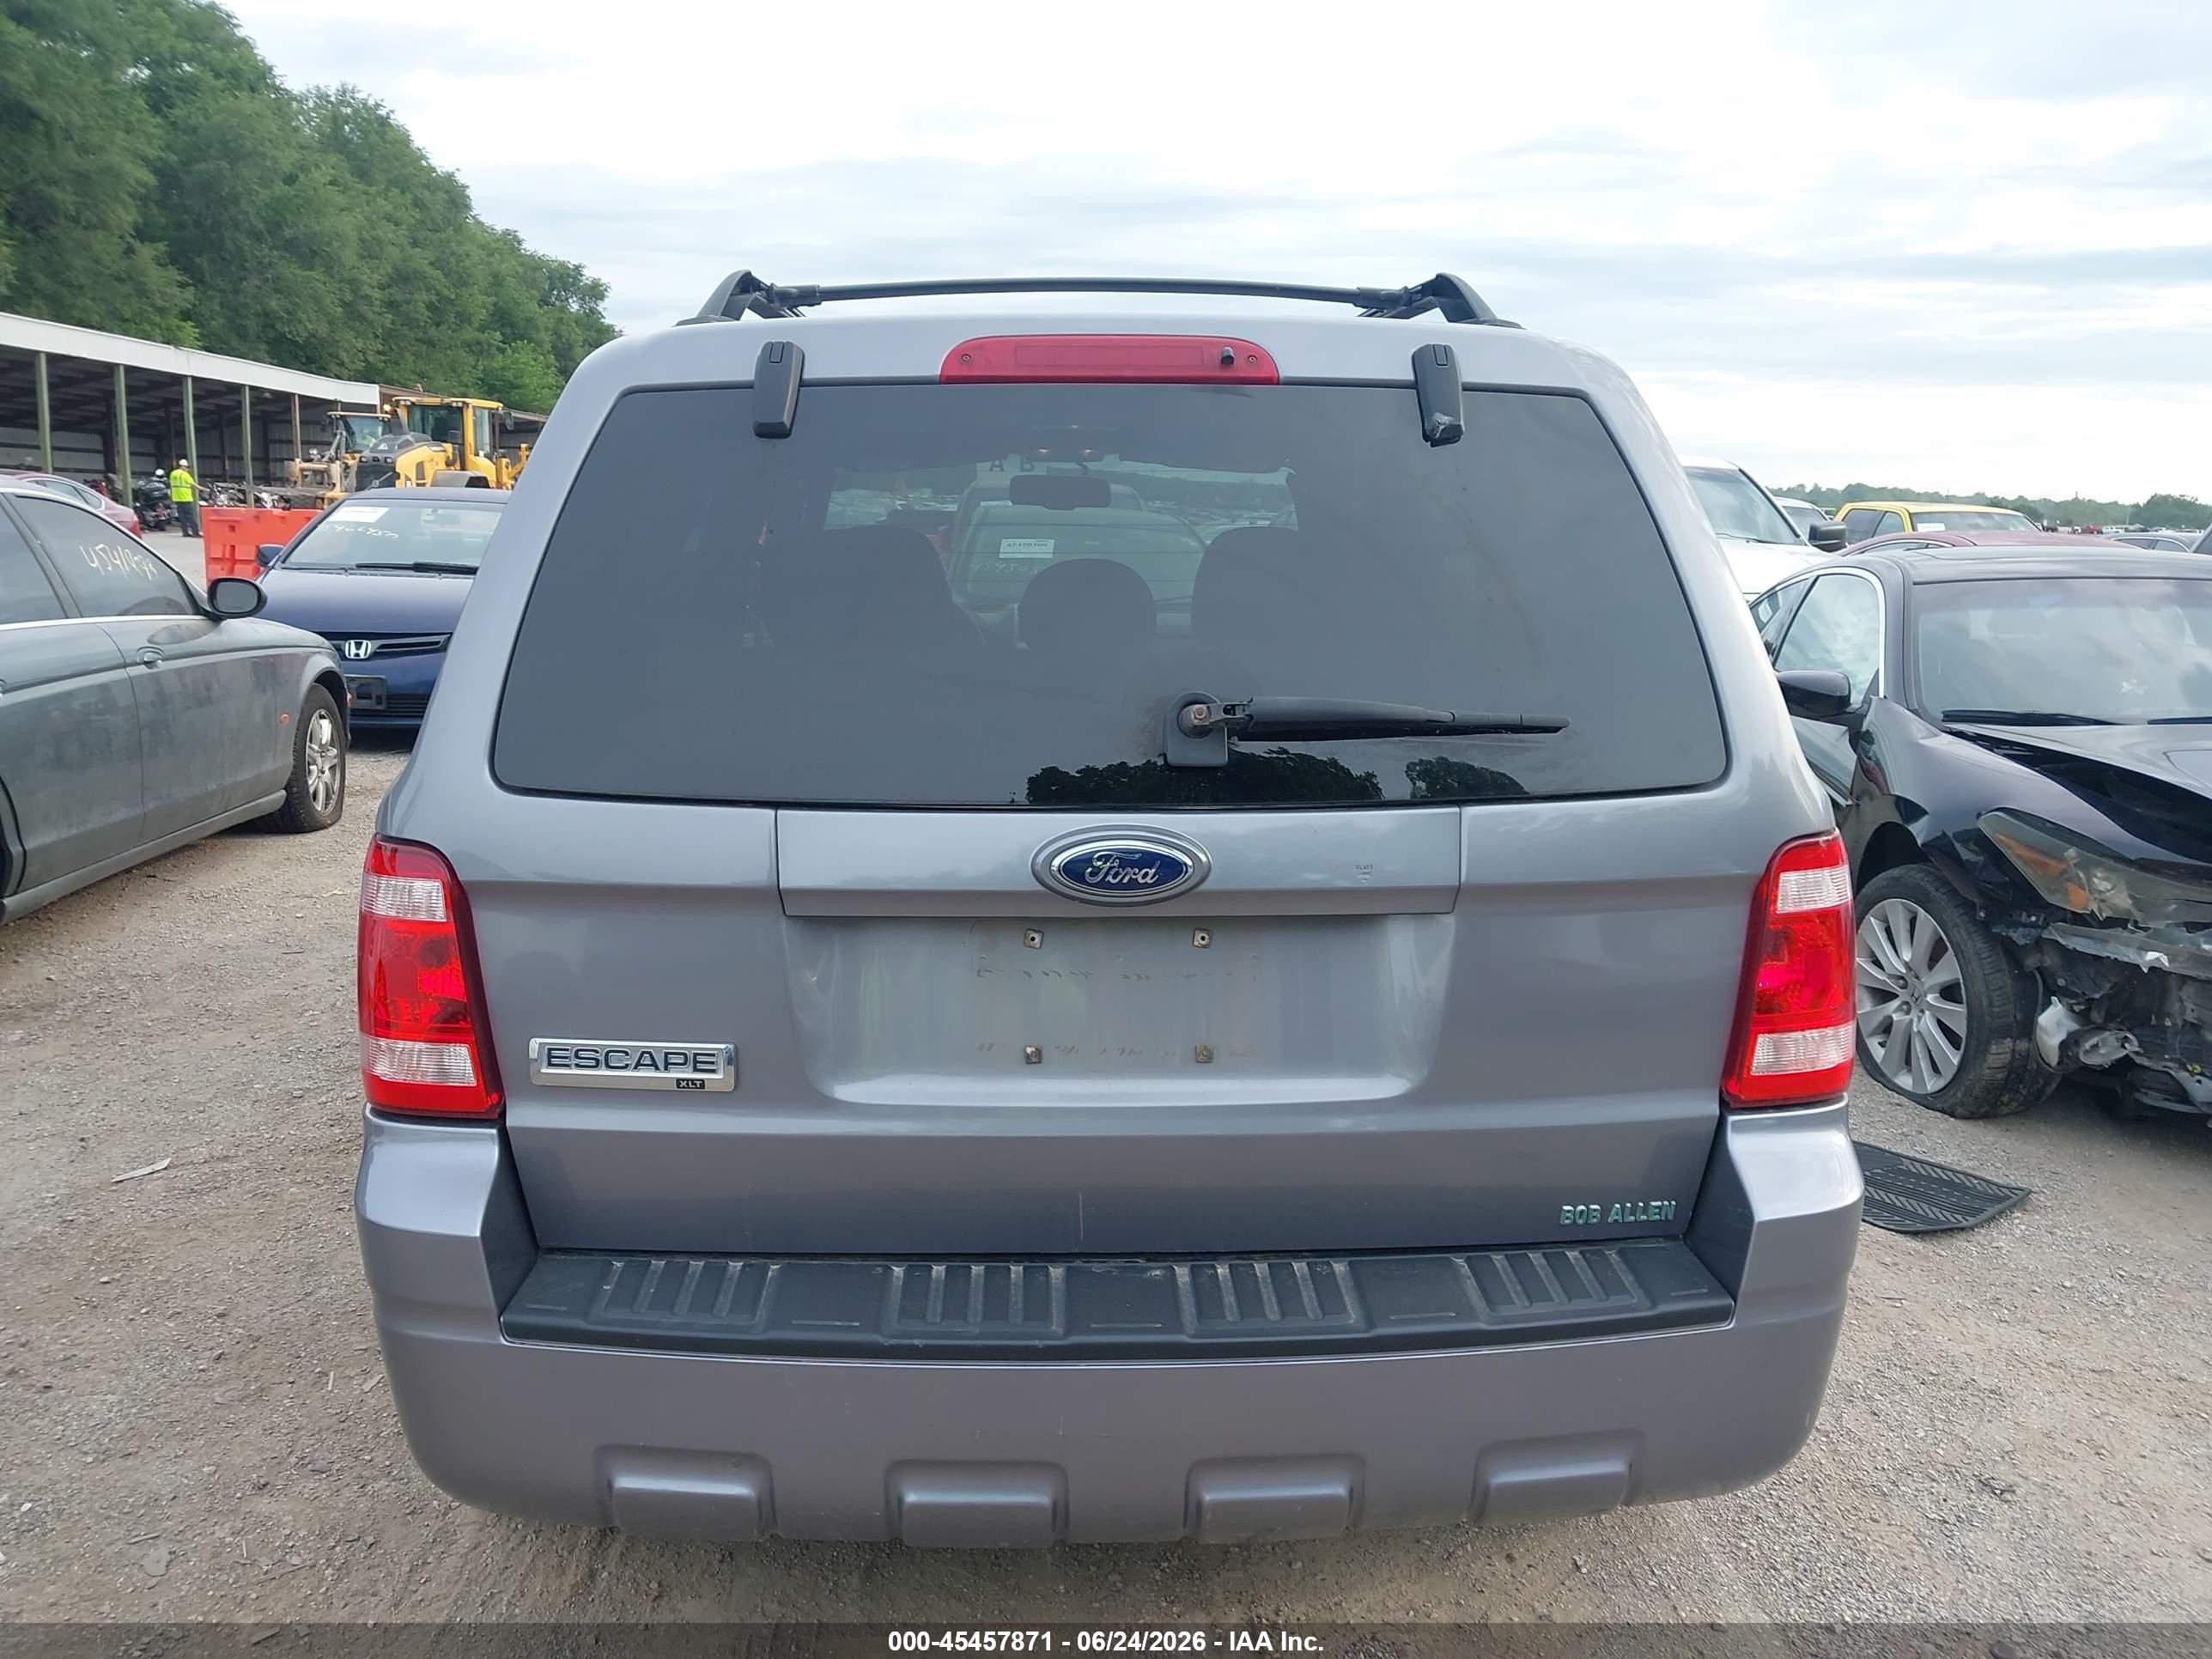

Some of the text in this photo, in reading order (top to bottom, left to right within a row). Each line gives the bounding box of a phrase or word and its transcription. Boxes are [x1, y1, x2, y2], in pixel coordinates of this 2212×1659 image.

[1085, 851, 1161, 884] Ford
[546, 1046, 718, 1074] ESCAPE
[678, 1079, 704, 1089] XLT
[1559, 1200, 1677, 1225] BOB ALLEN
